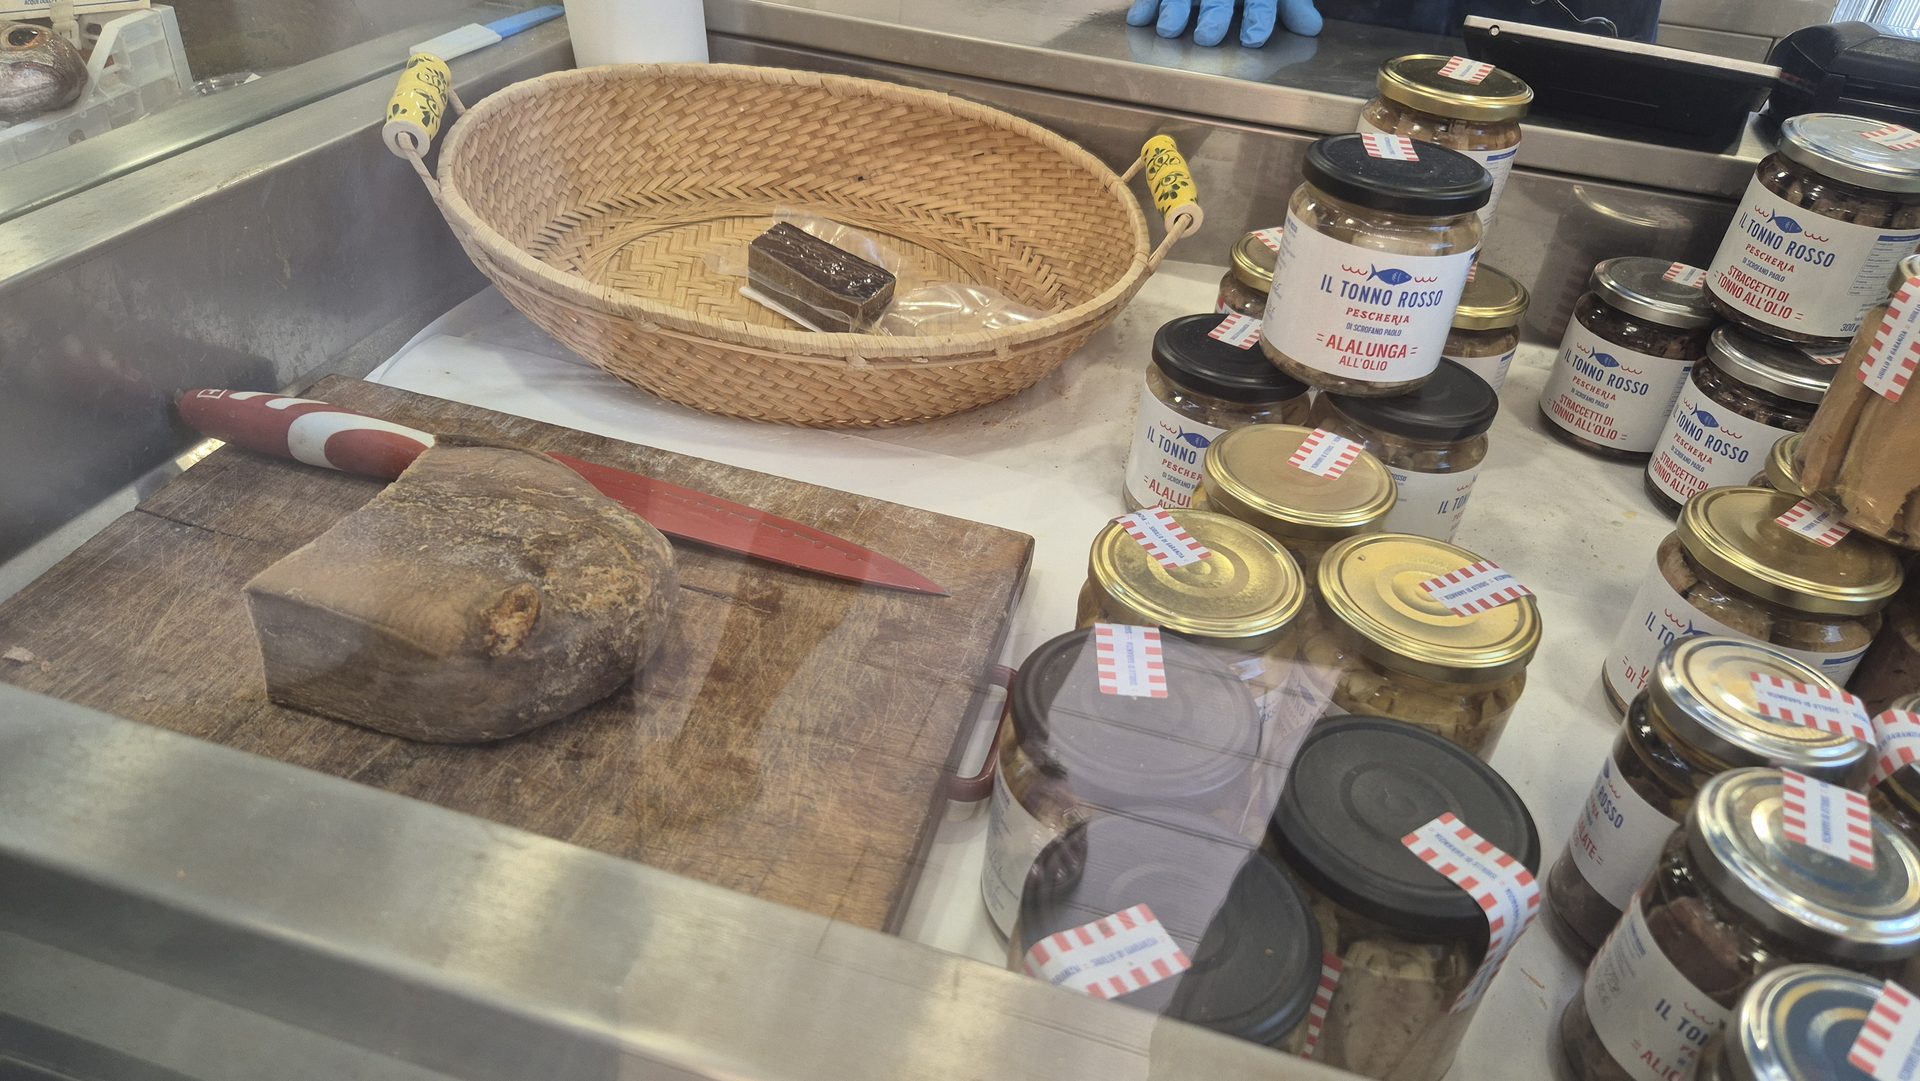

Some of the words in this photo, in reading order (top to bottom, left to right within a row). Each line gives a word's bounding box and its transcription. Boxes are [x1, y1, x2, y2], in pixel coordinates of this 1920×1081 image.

[1739, 212, 1748, 229] IL
[1746, 219, 1784, 250] TONNO
[1785, 240, 1836, 268] ROSSO
[1745, 243, 1794, 273] PESCHERIA
[1727, 265, 1776, 299] STRACCETTI
[1776, 291, 1790, 303] DI
[1768, 270, 1786, 283] PAOLO
[1320, 274, 1333, 294] IL
[1340, 280, 1393, 307] TONNO
[1397, 289, 1444, 308] ROSSO
[1717, 272, 1744, 299] TONNO
[1742, 291, 1793, 320] ALL'OLIO
[1345, 307, 1410, 326] PESCHERIA
[1346, 322, 1353, 331] DI
[1353, 323, 1384, 336] SCROFANO
[1325, 334, 1408, 359] ALALUNGA
[1338, 355, 1388, 371] ALL'OLIO
[1564, 348, 1572, 363] IL
[1571, 355, 1605, 382] TONNO
[1606, 373, 1649, 396] ROSSO
[1572, 375, 1616, 401] PESCHERIA
[1559, 394, 1602, 422] STRACCETTI
[1603, 415, 1614, 427] DI
[1594, 398, 1609, 409] PAOLO
[1551, 400, 1575, 424] TONNO
[1574, 417, 1618, 441] ALL'OLIO
[1147, 426, 1155, 443] IL
[1159, 434, 1197, 465] TONNO
[1673, 432, 1713, 465] PESCHERIA
[1676, 411, 1704, 442] TONNO
[1704, 434, 1749, 463] ROSSO
[1653, 457, 1671, 483] TONNO
[1660, 451, 1697, 487] STRACCETTI
[1697, 480, 1709, 491] DI
[1437, 500, 1449, 515] IL
[1645, 611, 1656, 632] IL
[1625, 666, 1637, 683] DI
[1655, 998, 1671, 1021] IL
